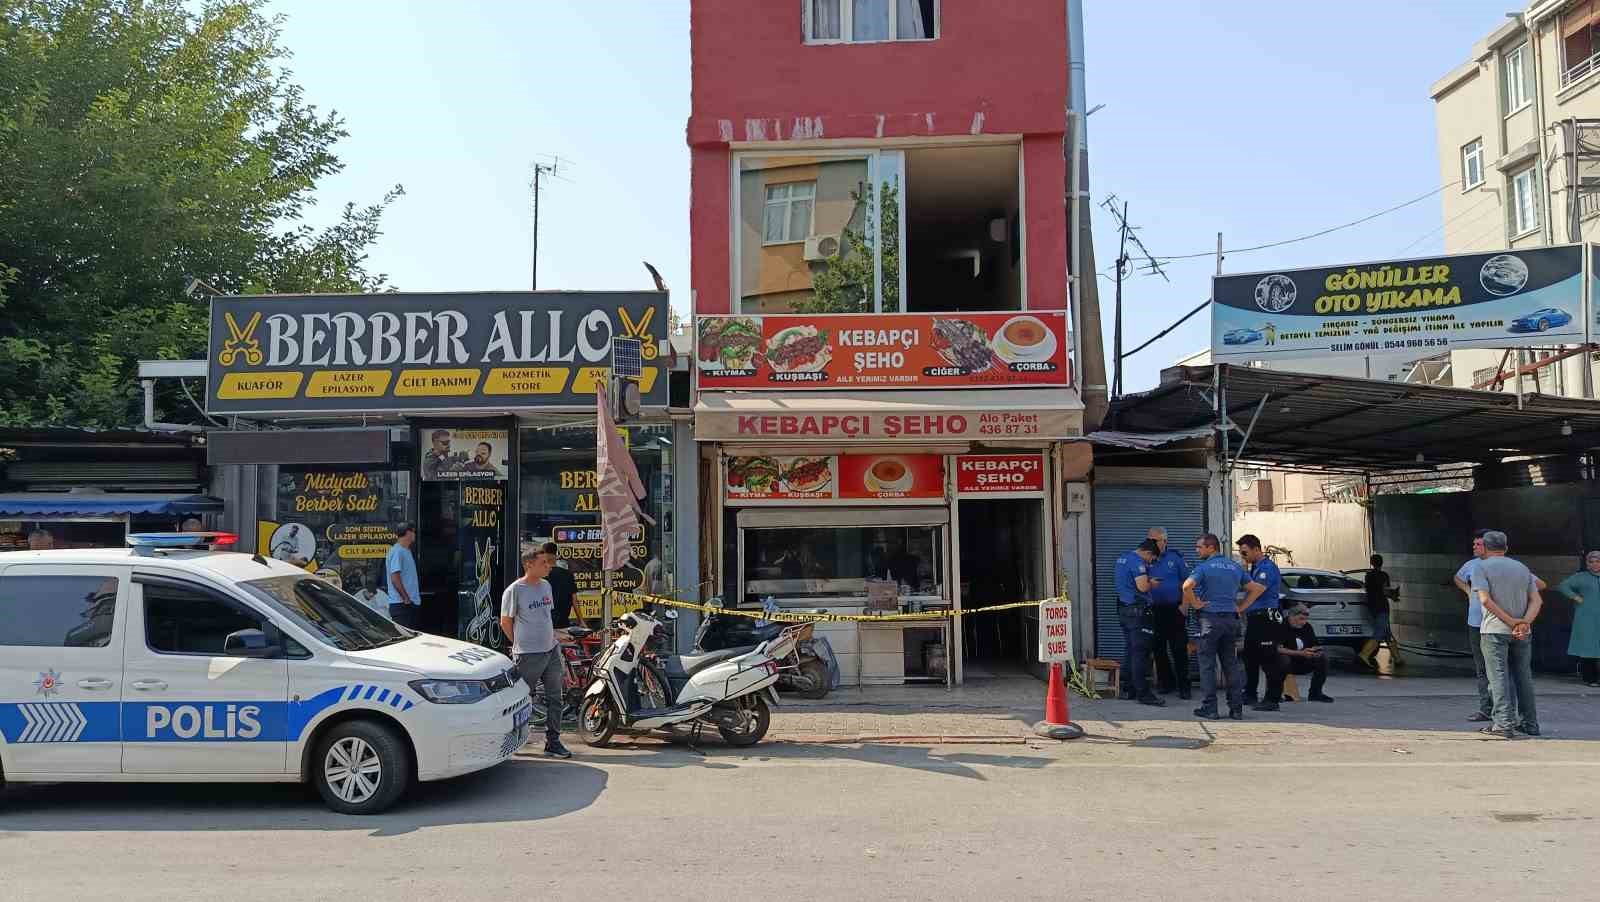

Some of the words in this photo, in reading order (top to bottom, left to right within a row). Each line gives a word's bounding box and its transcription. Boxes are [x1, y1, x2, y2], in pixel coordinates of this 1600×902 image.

[1325, 264, 1450, 291] GÖNÜLLER
[1314, 294, 1361, 314] OTO
[1366, 286, 1461, 313] YIKAMA
[1421, 314, 1455, 322] YIKAMA
[1280, 331, 1311, 340] DETAYLI
[1470, 320, 1504, 329] YAPILIR
[265, 309, 470, 366] BERBER
[480, 309, 613, 363] ALLO
[838, 329, 919, 349] KEBAPÇI
[1331, 341, 1352, 352] SELİM
[1355, 340, 1380, 351] GÖNÜL
[1385, 340, 1405, 349] 0544
[1407, 339, 1423, 348] 960
[854, 351, 905, 373] ŞEHO
[1016, 363, 1050, 372] ÇORBA
[333, 373, 366, 382] LAZER
[712, 369, 747, 377] KIYMA
[775, 373, 822, 382] KUŞBAŞI
[930, 366, 961, 376] CİĞER
[402, 376, 426, 388] CİLT
[432, 376, 472, 388] BAKIMI
[889, 375, 919, 383] VARDIR
[511, 382, 543, 391] STORE
[979, 413, 999, 424] Alo
[1003, 412, 1040, 424] Paket
[738, 415, 870, 438] KEBAPÇI
[883, 415, 967, 438] ŞEHO
[979, 424, 1001, 435] 436
[1005, 424, 1022, 434] 87
[1026, 424, 1040, 434] 31
[962, 460, 1038, 472] KEBAPÇI
[560, 470, 599, 489] BER
[976, 473, 1025, 485] ŞEHO
[465, 486, 503, 506] BERBER
[575, 493, 600, 512] AL
[295, 494, 344, 512] Berber
[347, 494, 378, 512] Sait
[472, 510, 497, 528] ALLO
[1045, 607, 1068, 620] TOROS
